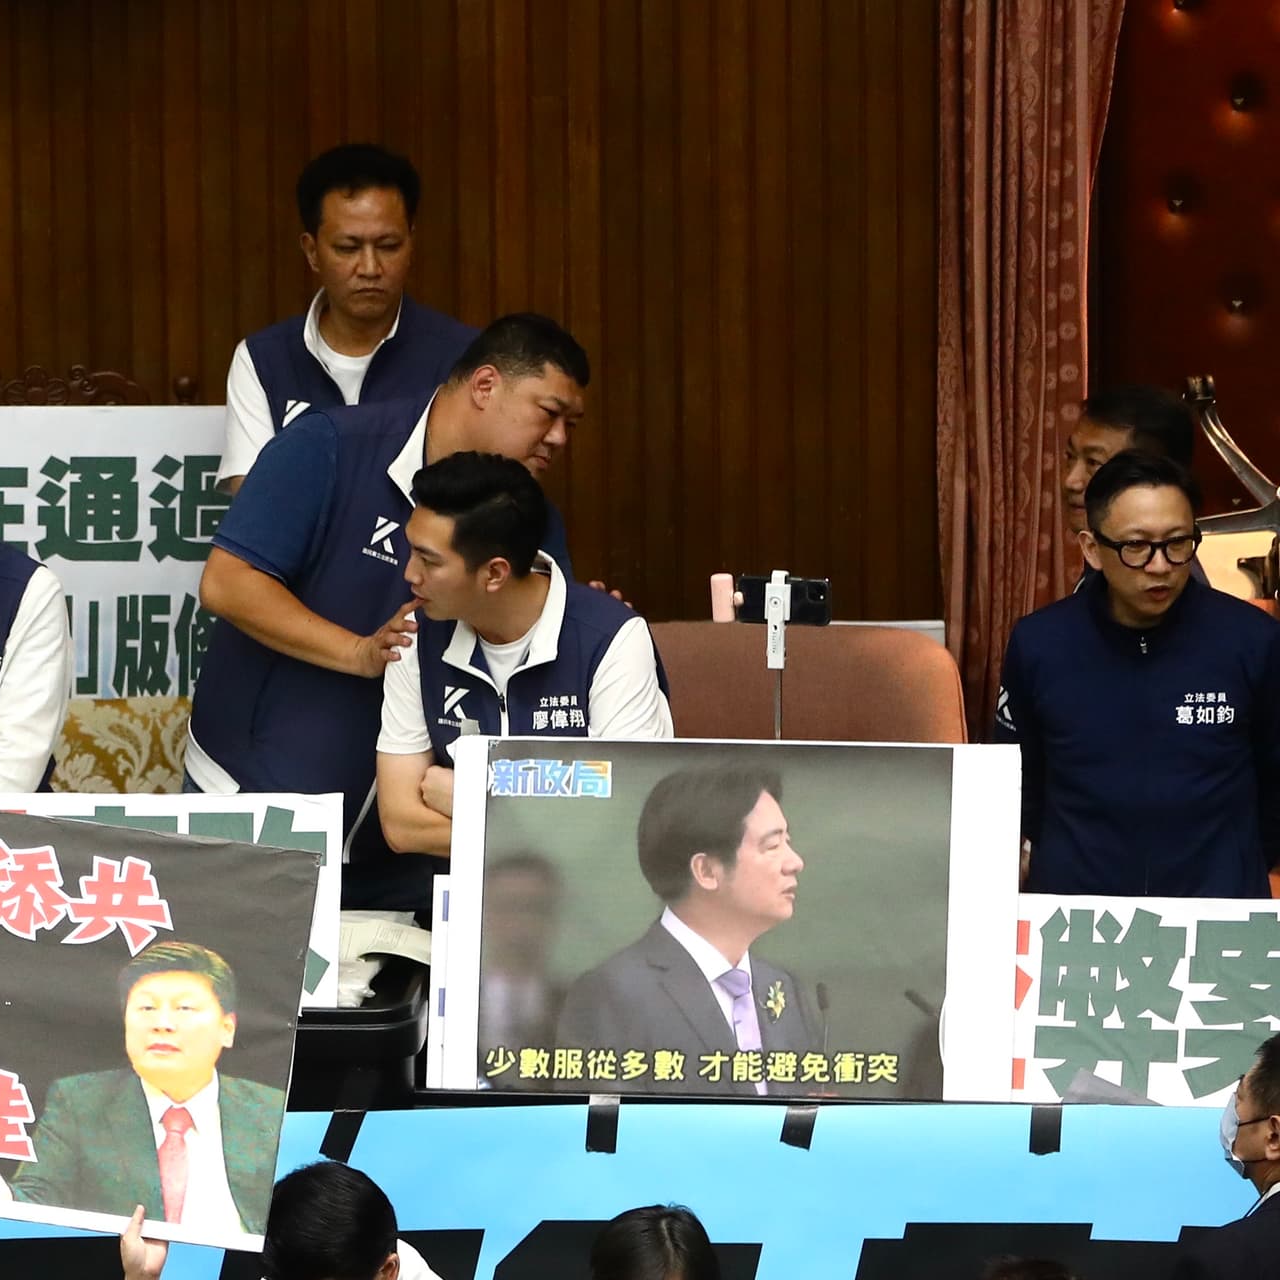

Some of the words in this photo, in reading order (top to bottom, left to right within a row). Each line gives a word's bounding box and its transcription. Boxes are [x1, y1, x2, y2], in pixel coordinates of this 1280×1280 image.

[539, 695, 578, 707] 立法委員
[1184, 692, 1227, 703] 立法委員
[1175, 705, 1235, 725] 葛如鈞
[490, 759, 612, 799] 新政局
[485, 1048, 686, 1083] 少數服從多數
[698, 1050, 900, 1084] 才能避免衝突
